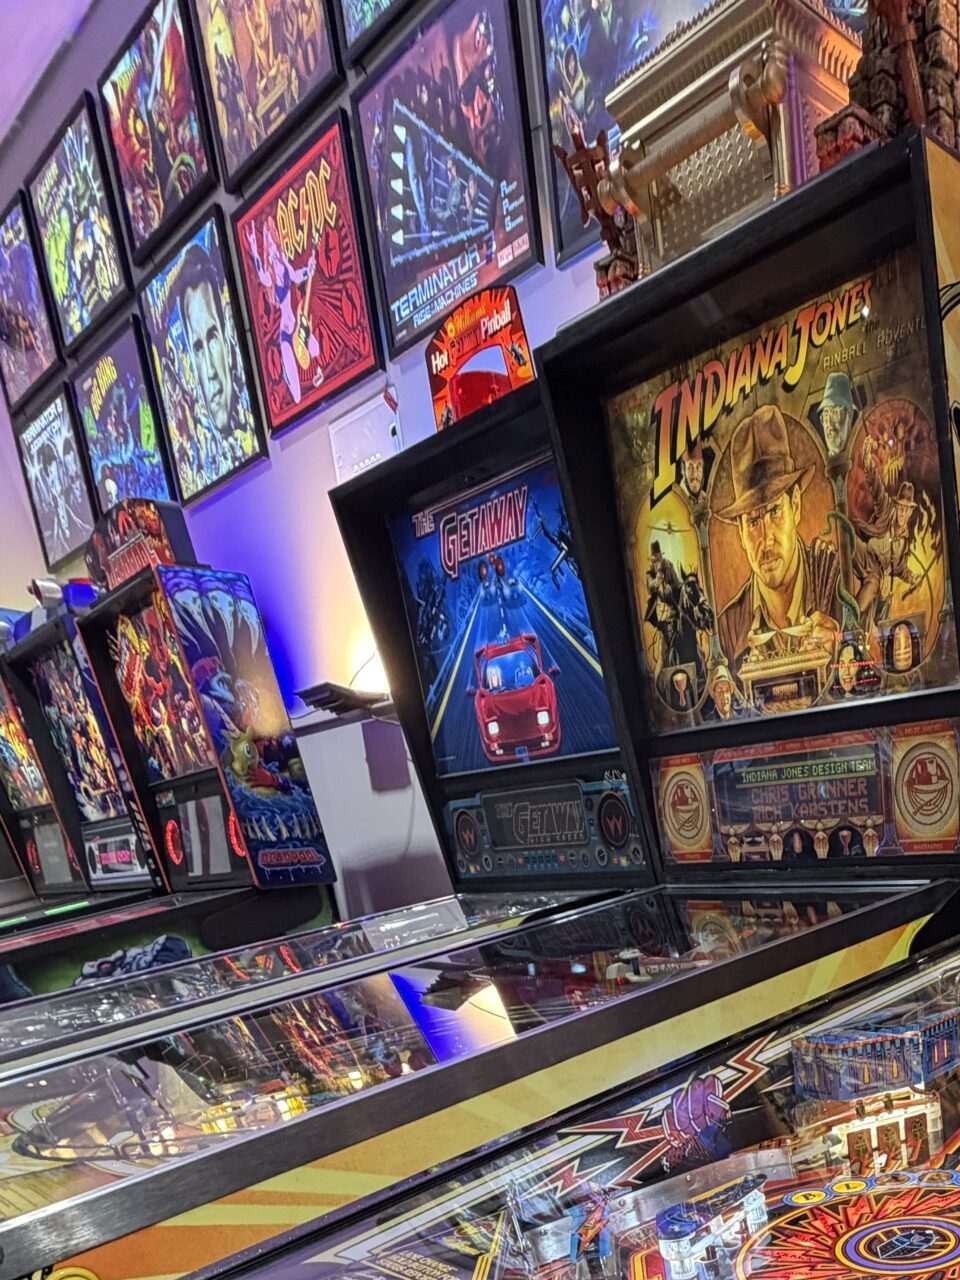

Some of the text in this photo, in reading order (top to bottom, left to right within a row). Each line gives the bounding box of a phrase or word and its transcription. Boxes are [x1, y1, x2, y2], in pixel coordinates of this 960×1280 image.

[390, 247, 480, 322] TERMINATOR
[480, 298, 512, 340] Pinball
[822, 343, 867, 371] PINBALL
[651, 278, 874, 502] INDIANA JONES
[412, 485, 529, 579] THE GETAWAY
[741, 768, 778, 784] INDIANA
[781, 764, 809, 779] JONES
[812, 762, 849, 776] DESIGN
[751, 779, 868, 804] CHRIS GRNNER
[752, 799, 869, 822] RICH KARSTENS
